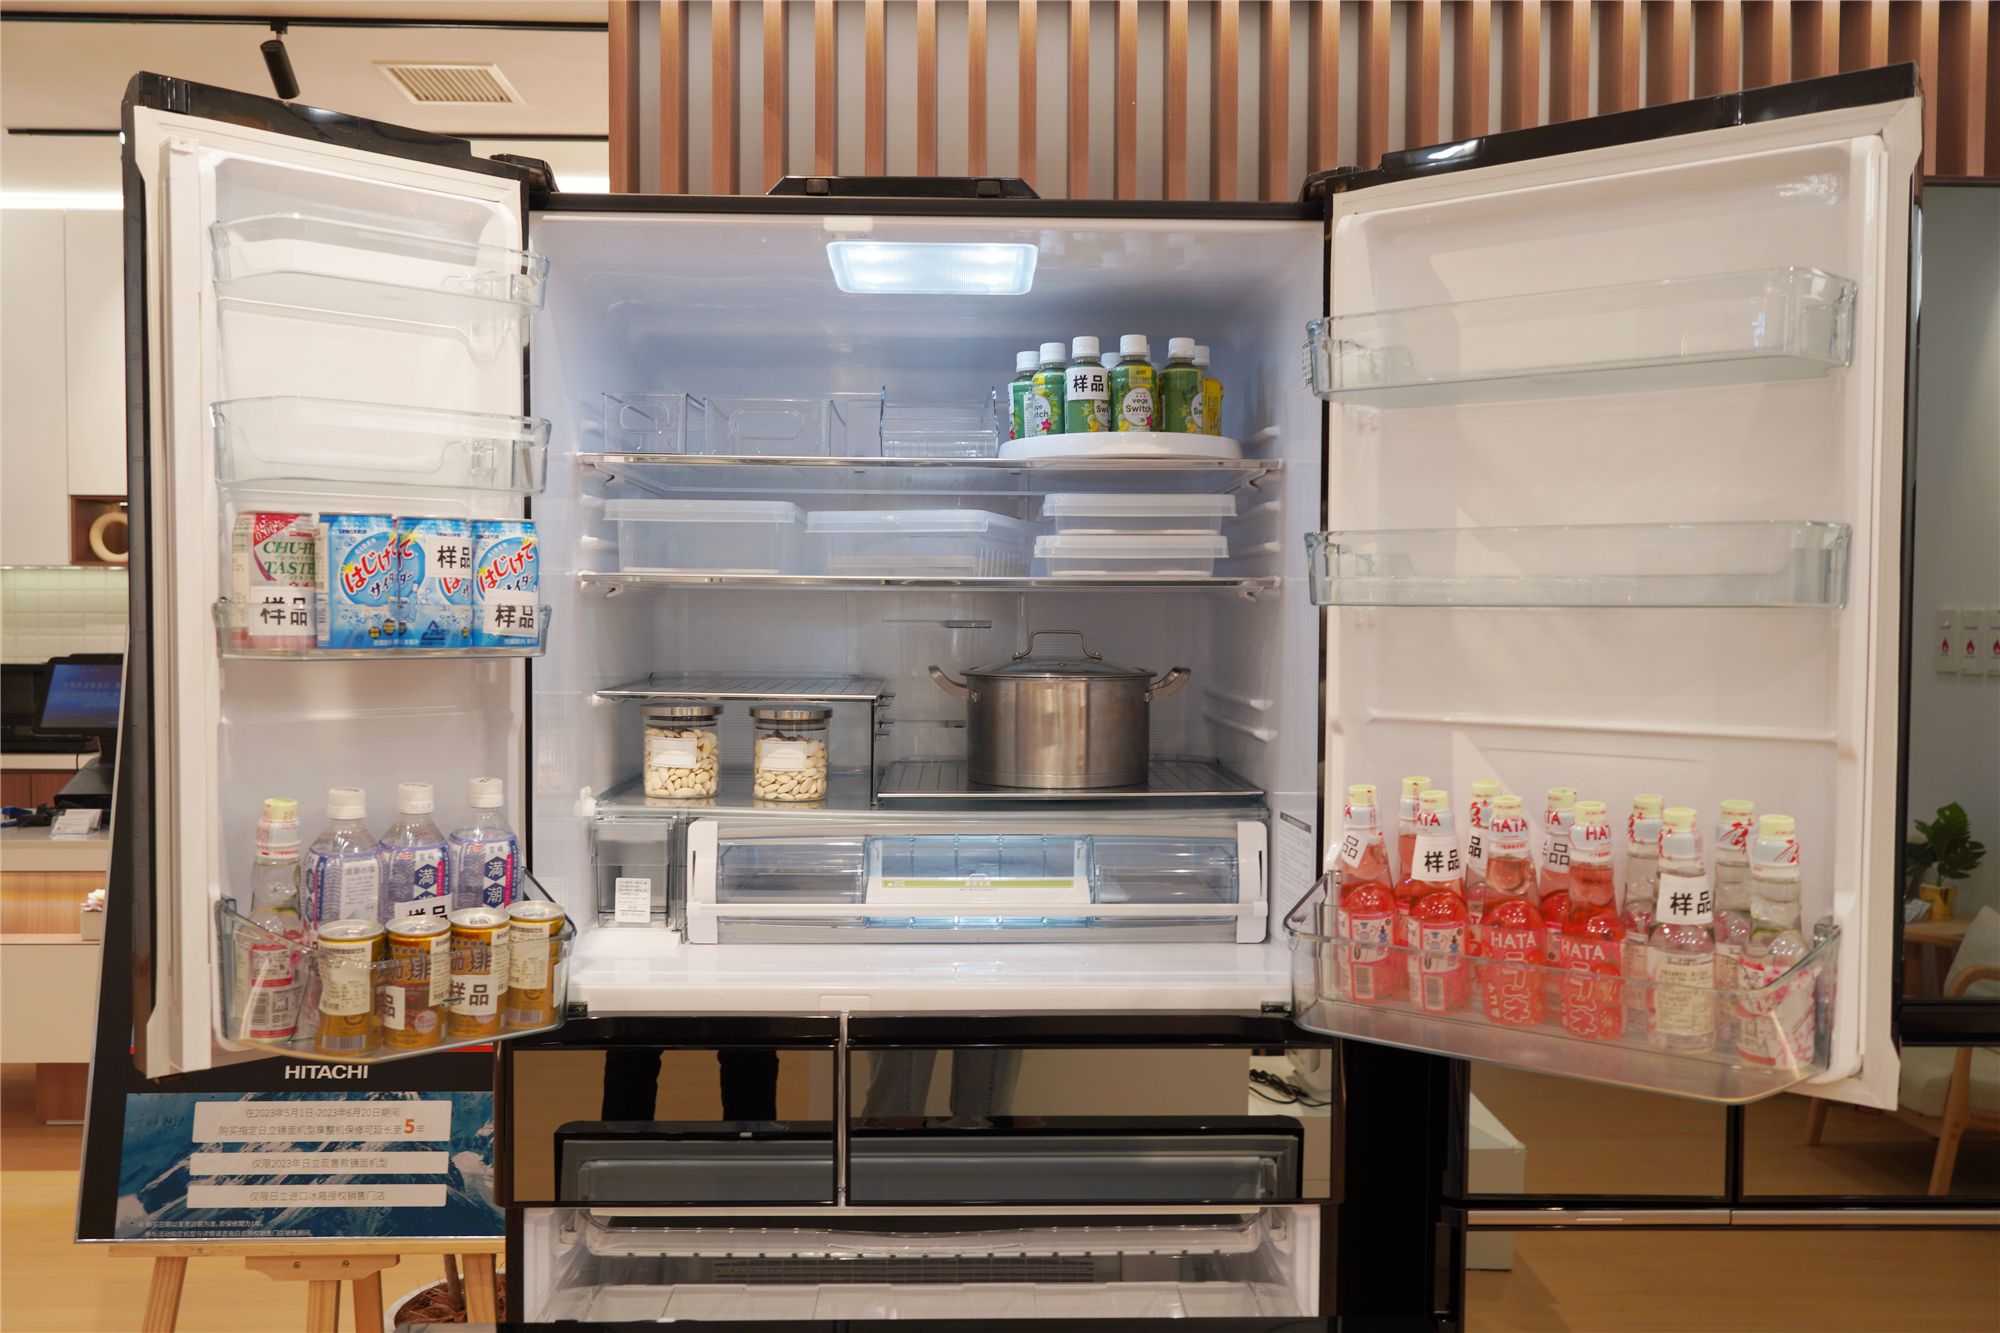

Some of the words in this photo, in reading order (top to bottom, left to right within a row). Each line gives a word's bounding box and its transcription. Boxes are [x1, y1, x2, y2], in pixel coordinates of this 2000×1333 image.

[1073, 374, 1104, 393] 样品
[1096, 405, 1109, 413] Swi
[1125, 405, 1152, 413] Switch
[1193, 407, 1203, 415] Sw
[344, 537, 397, 594] はじけて
[437, 545, 471, 569] 样品
[263, 562, 316, 576] TASTE
[479, 542, 535, 593] はじけて
[260, 596, 309, 626] 样品
[494, 603, 535, 629] 样品
[1490, 818, 1528, 833] HATA
[1424, 848, 1460, 873] 样品
[1669, 890, 1711, 916] 样品
[1490, 931, 1537, 950] HATA
[1561, 939, 1606, 961] HATA
[284, 1064, 369, 1080] HITACHI
